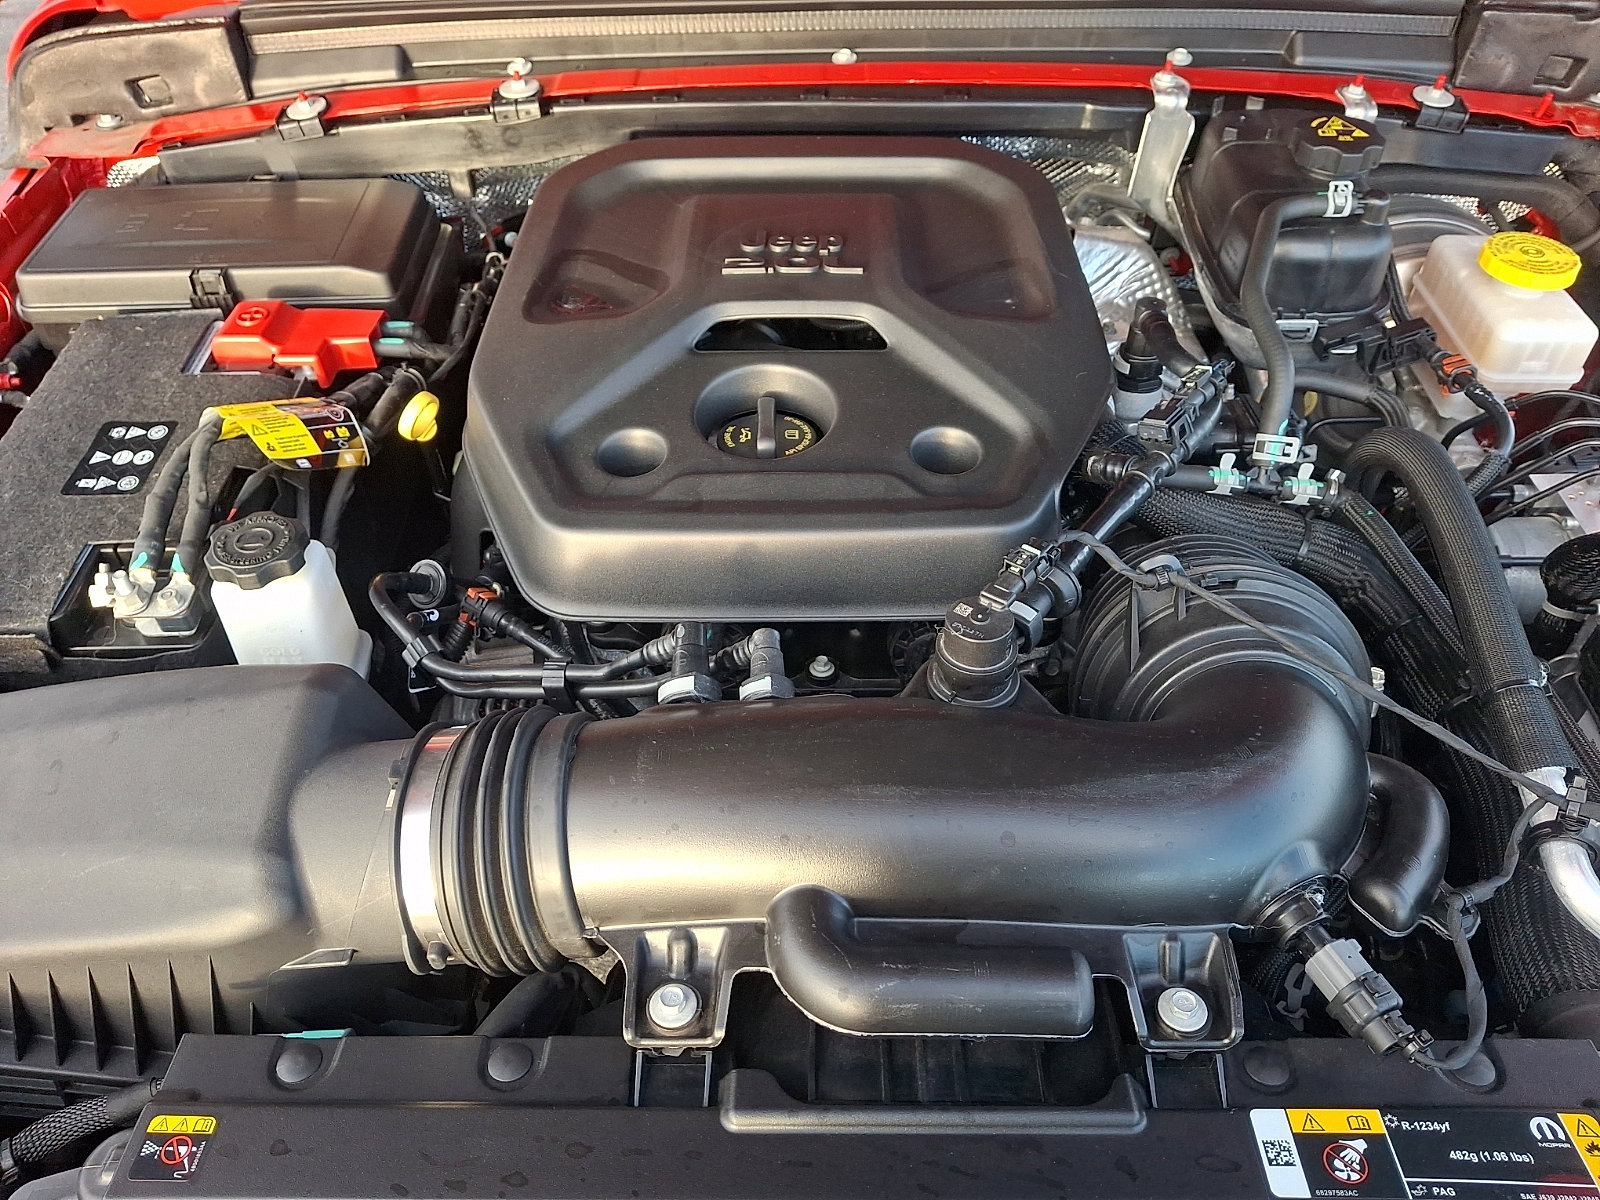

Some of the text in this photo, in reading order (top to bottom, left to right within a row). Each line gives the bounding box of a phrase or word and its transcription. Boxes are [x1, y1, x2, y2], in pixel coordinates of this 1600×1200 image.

[740, 229, 844, 256] Jeep
[721, 257, 864, 275] 2.0L
[1401, 1120, 1450, 1133] R-1234yf
[1537, 1141, 1571, 1149] MOPAR
[1449, 1150, 1534, 1165] 482g (1.06 lbs)
[1432, 1186, 1456, 1197] PAG
